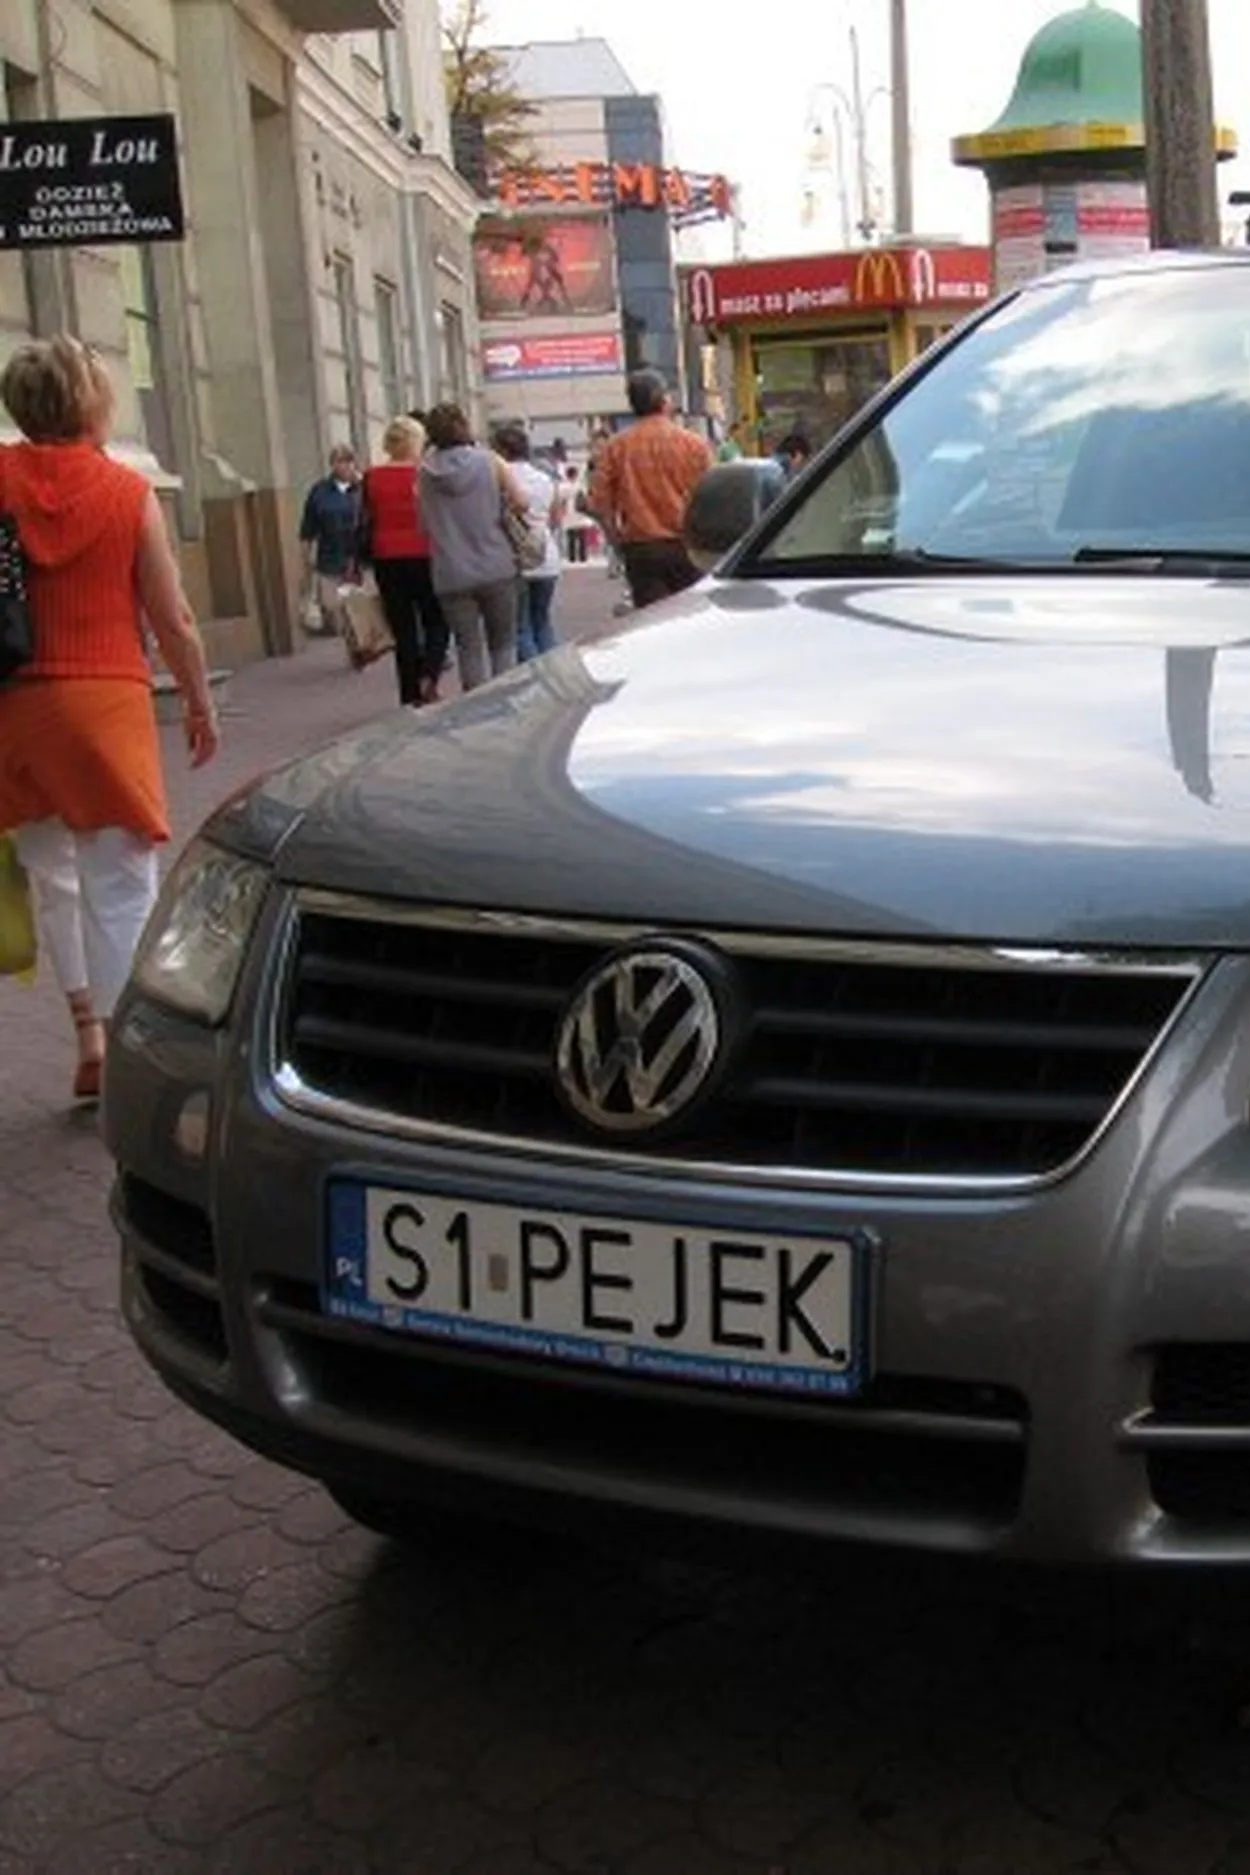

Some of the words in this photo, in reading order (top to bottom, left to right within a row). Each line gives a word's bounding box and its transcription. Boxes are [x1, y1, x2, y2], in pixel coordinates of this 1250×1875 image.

[0, 136, 67, 170] Lou
[90, 130, 159, 165] Lou
[719, 295, 762, 316] masz
[765, 292, 784, 313] za
[786, 282, 849, 314] plecami
[335, 1256, 363, 1287] PL
